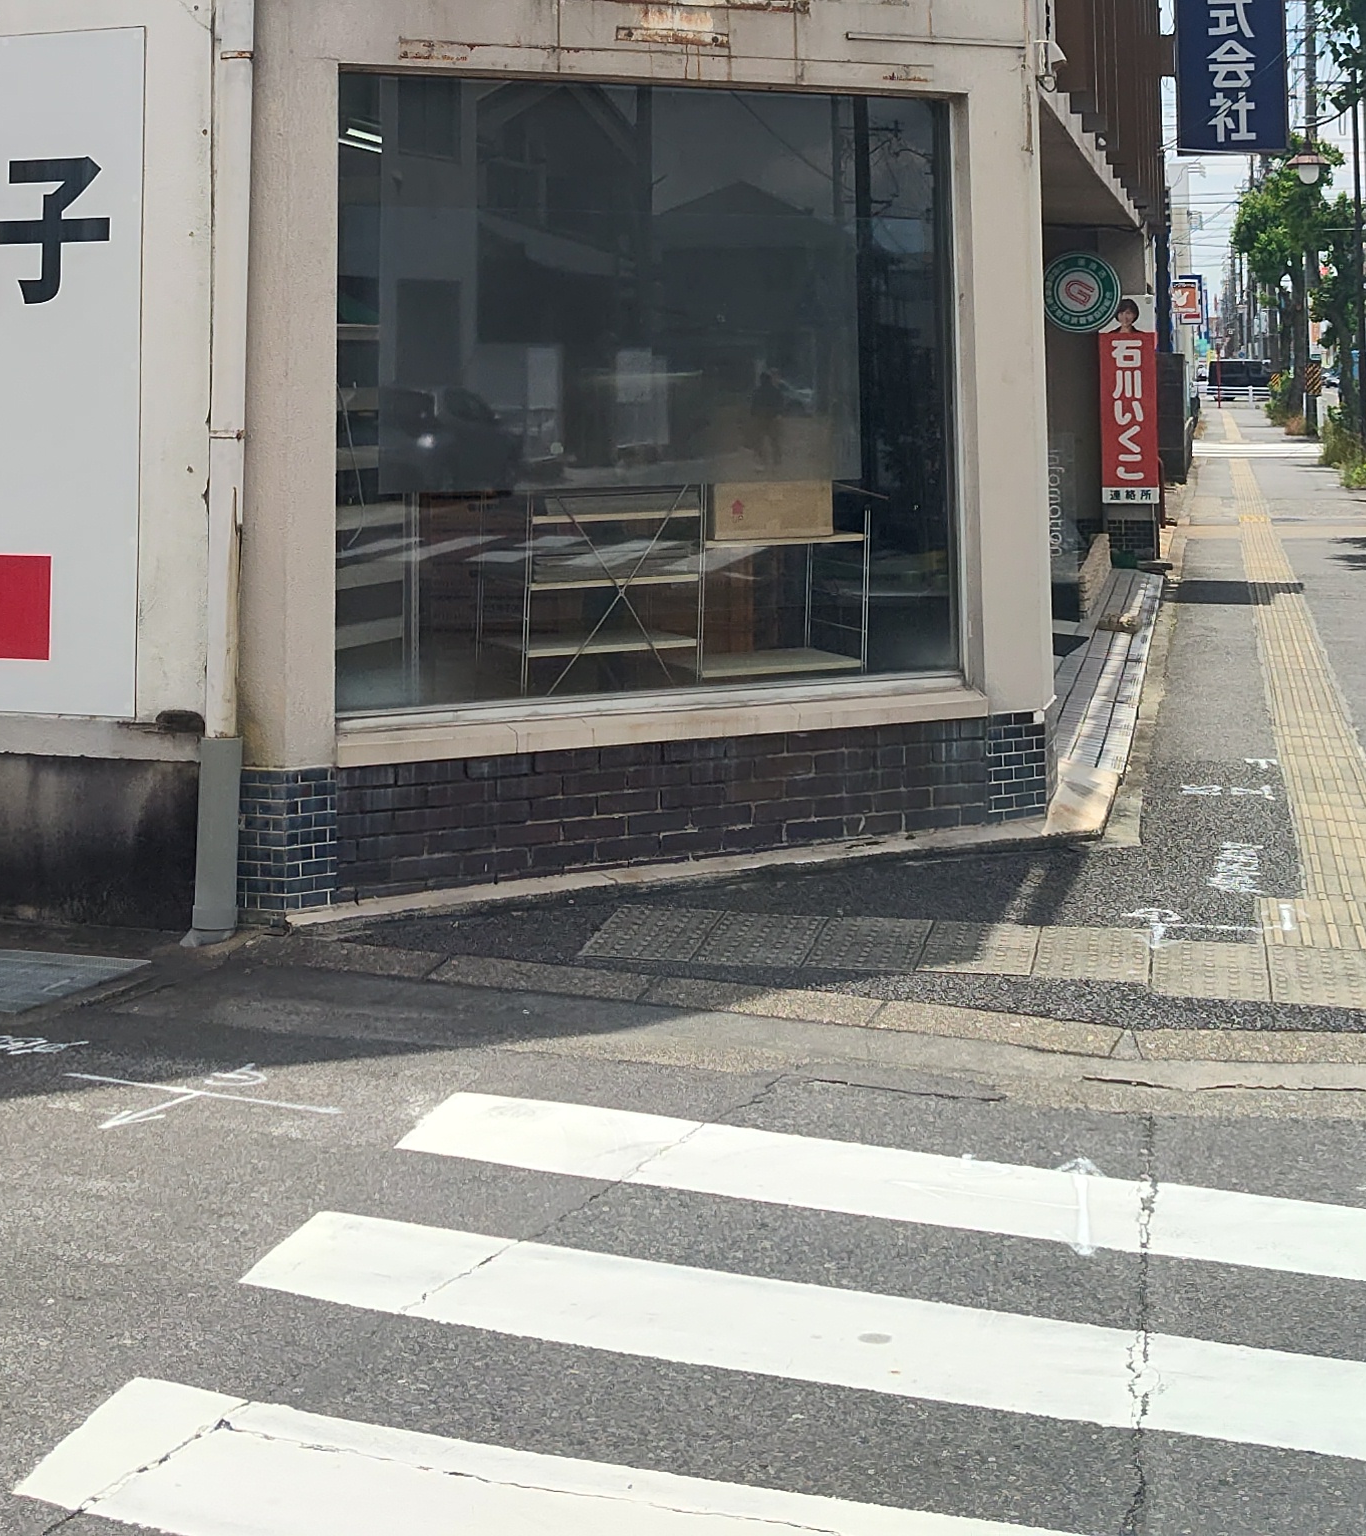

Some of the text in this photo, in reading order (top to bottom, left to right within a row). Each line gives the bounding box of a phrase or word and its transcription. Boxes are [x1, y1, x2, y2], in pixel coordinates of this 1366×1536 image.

[1110, 338, 1145, 481] 石川いくこ
[1109, 489, 1152, 502] 連絡所
